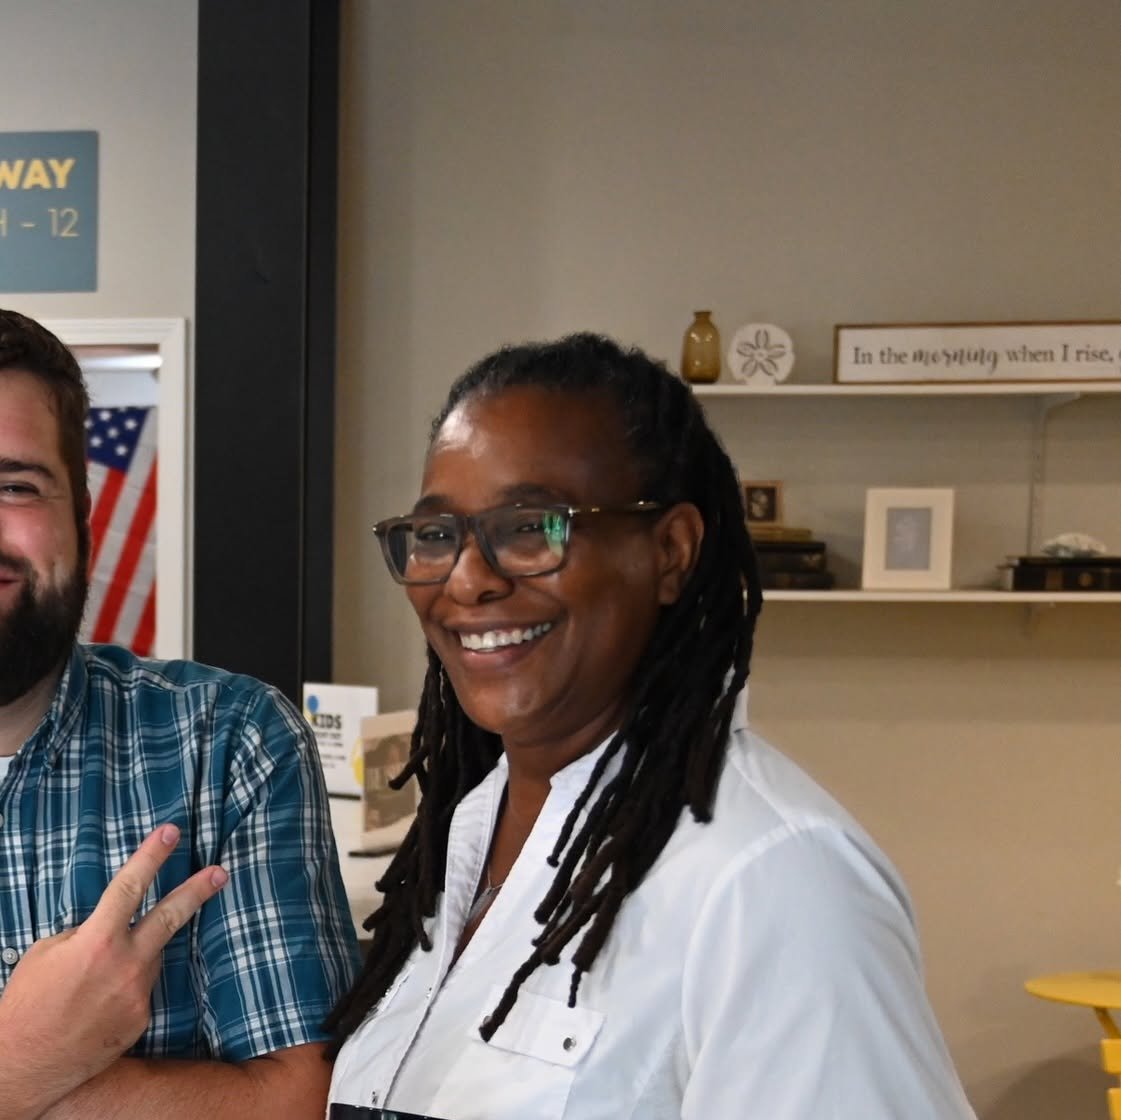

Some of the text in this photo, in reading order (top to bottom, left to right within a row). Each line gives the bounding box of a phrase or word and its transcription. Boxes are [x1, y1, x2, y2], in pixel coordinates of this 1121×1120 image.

[48, 208, 79, 237] 12
[852, 346, 873, 365] In
[879, 346, 909, 365] the
[1005, 344, 1055, 363] when
[1062, 343, 1070, 363] I
[1075, 343, 1114, 363] rise,
[311, 713, 342, 730] KIDS
